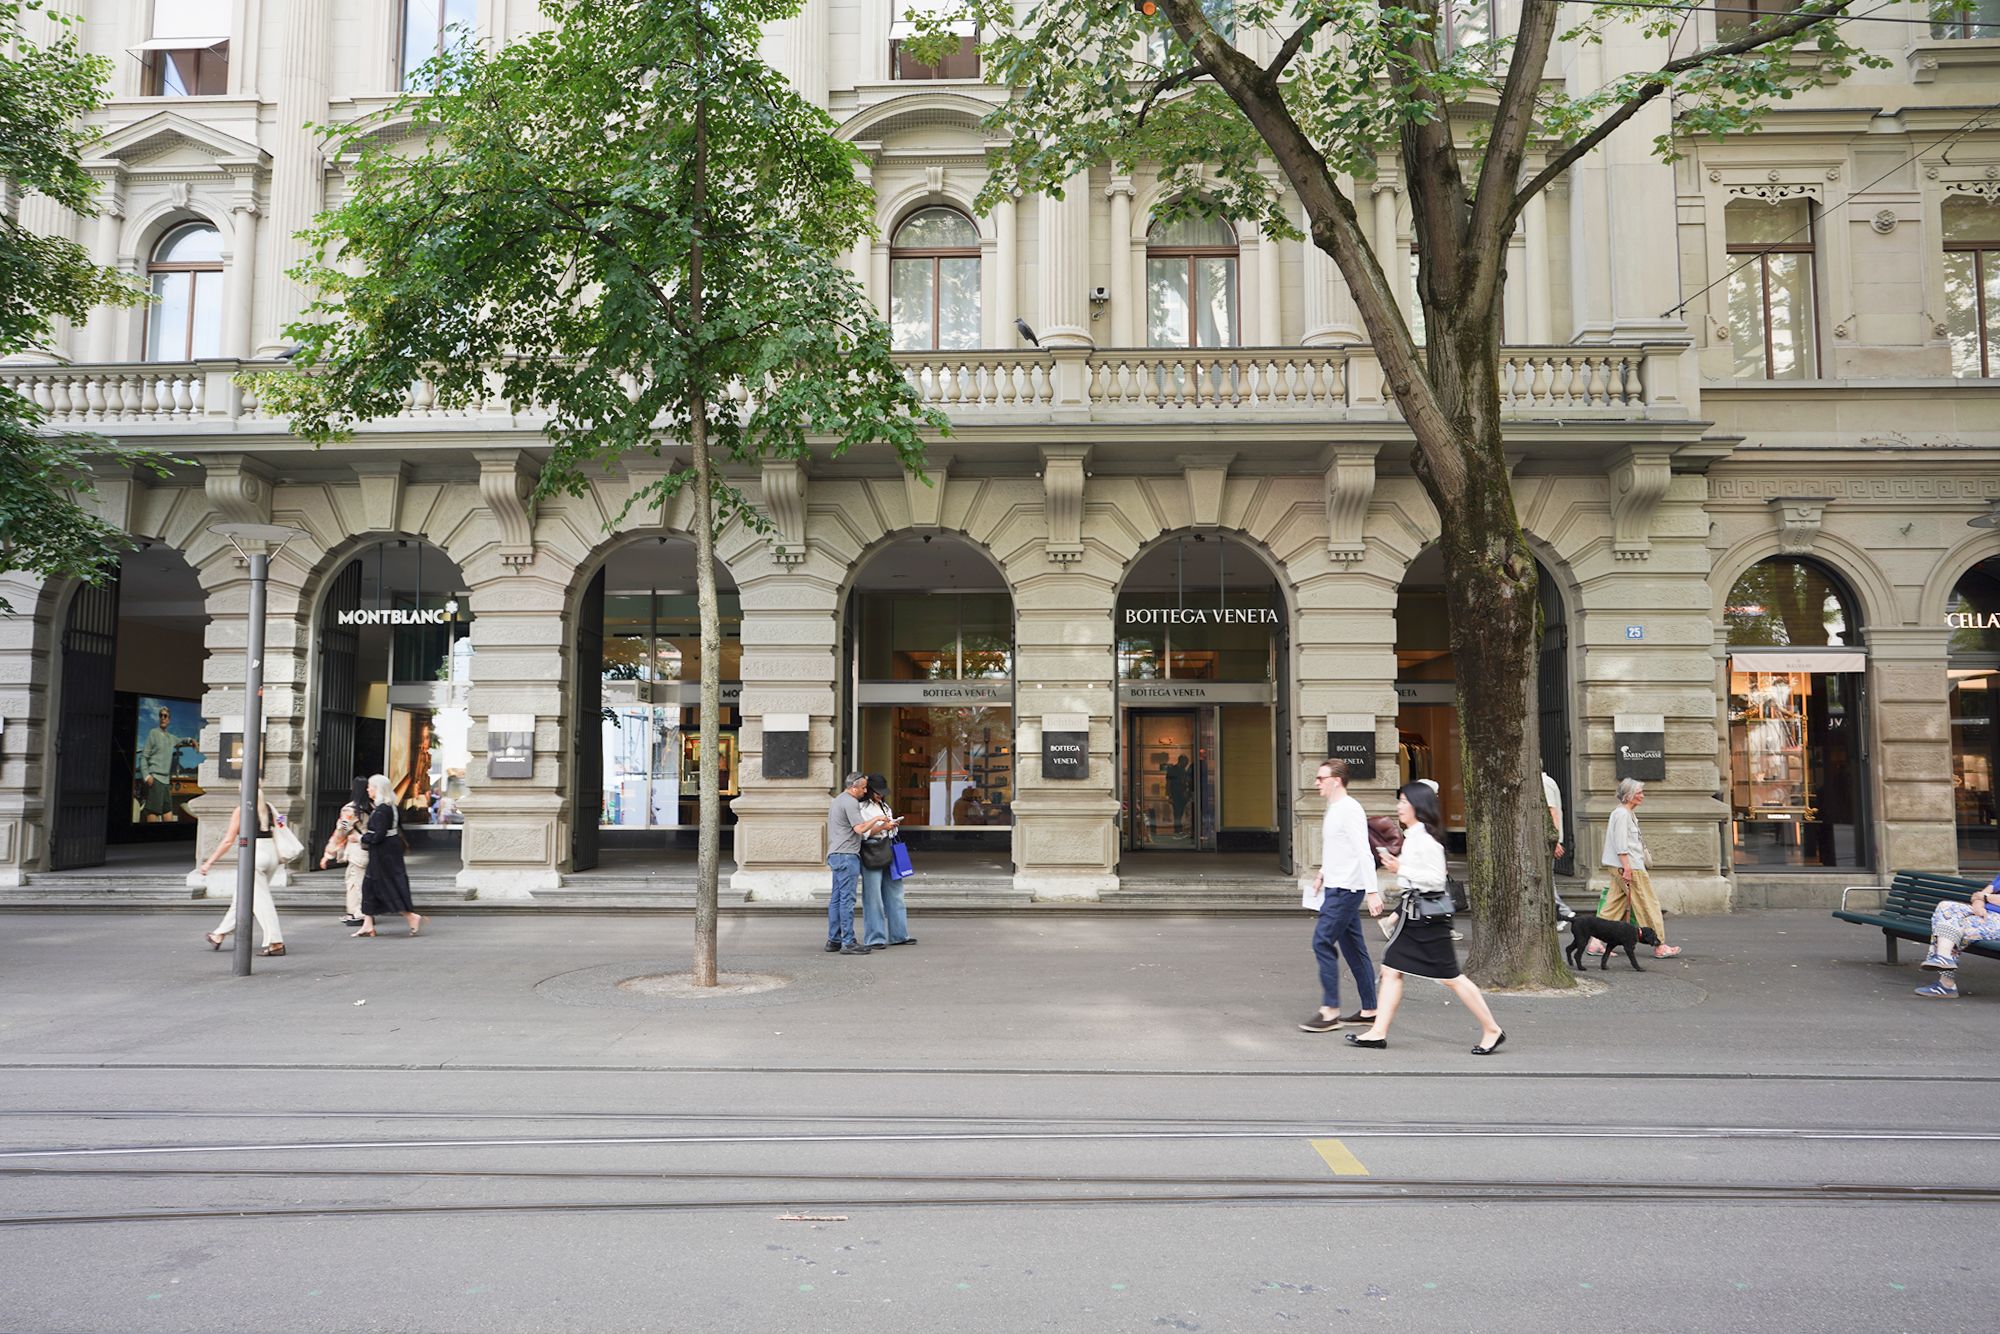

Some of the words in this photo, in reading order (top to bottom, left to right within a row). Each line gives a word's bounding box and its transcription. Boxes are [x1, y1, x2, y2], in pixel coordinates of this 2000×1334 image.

[338, 609, 444, 624] MONTBLANC
[1125, 609, 1207, 624] BOTTEGA
[1212, 609, 1279, 624] VENETA
[1944, 612, 2000, 628] CELLA
[1628, 627, 1641, 638] 25
[723, 689, 740, 698] MO
[923, 689, 962, 697] BOTTEGA
[964, 689, 997, 697] VENETA
[1130, 688, 1171, 697] BOTTEGA
[1173, 688, 1206, 697] VENETA
[1053, 757, 1078, 765] VENETA
